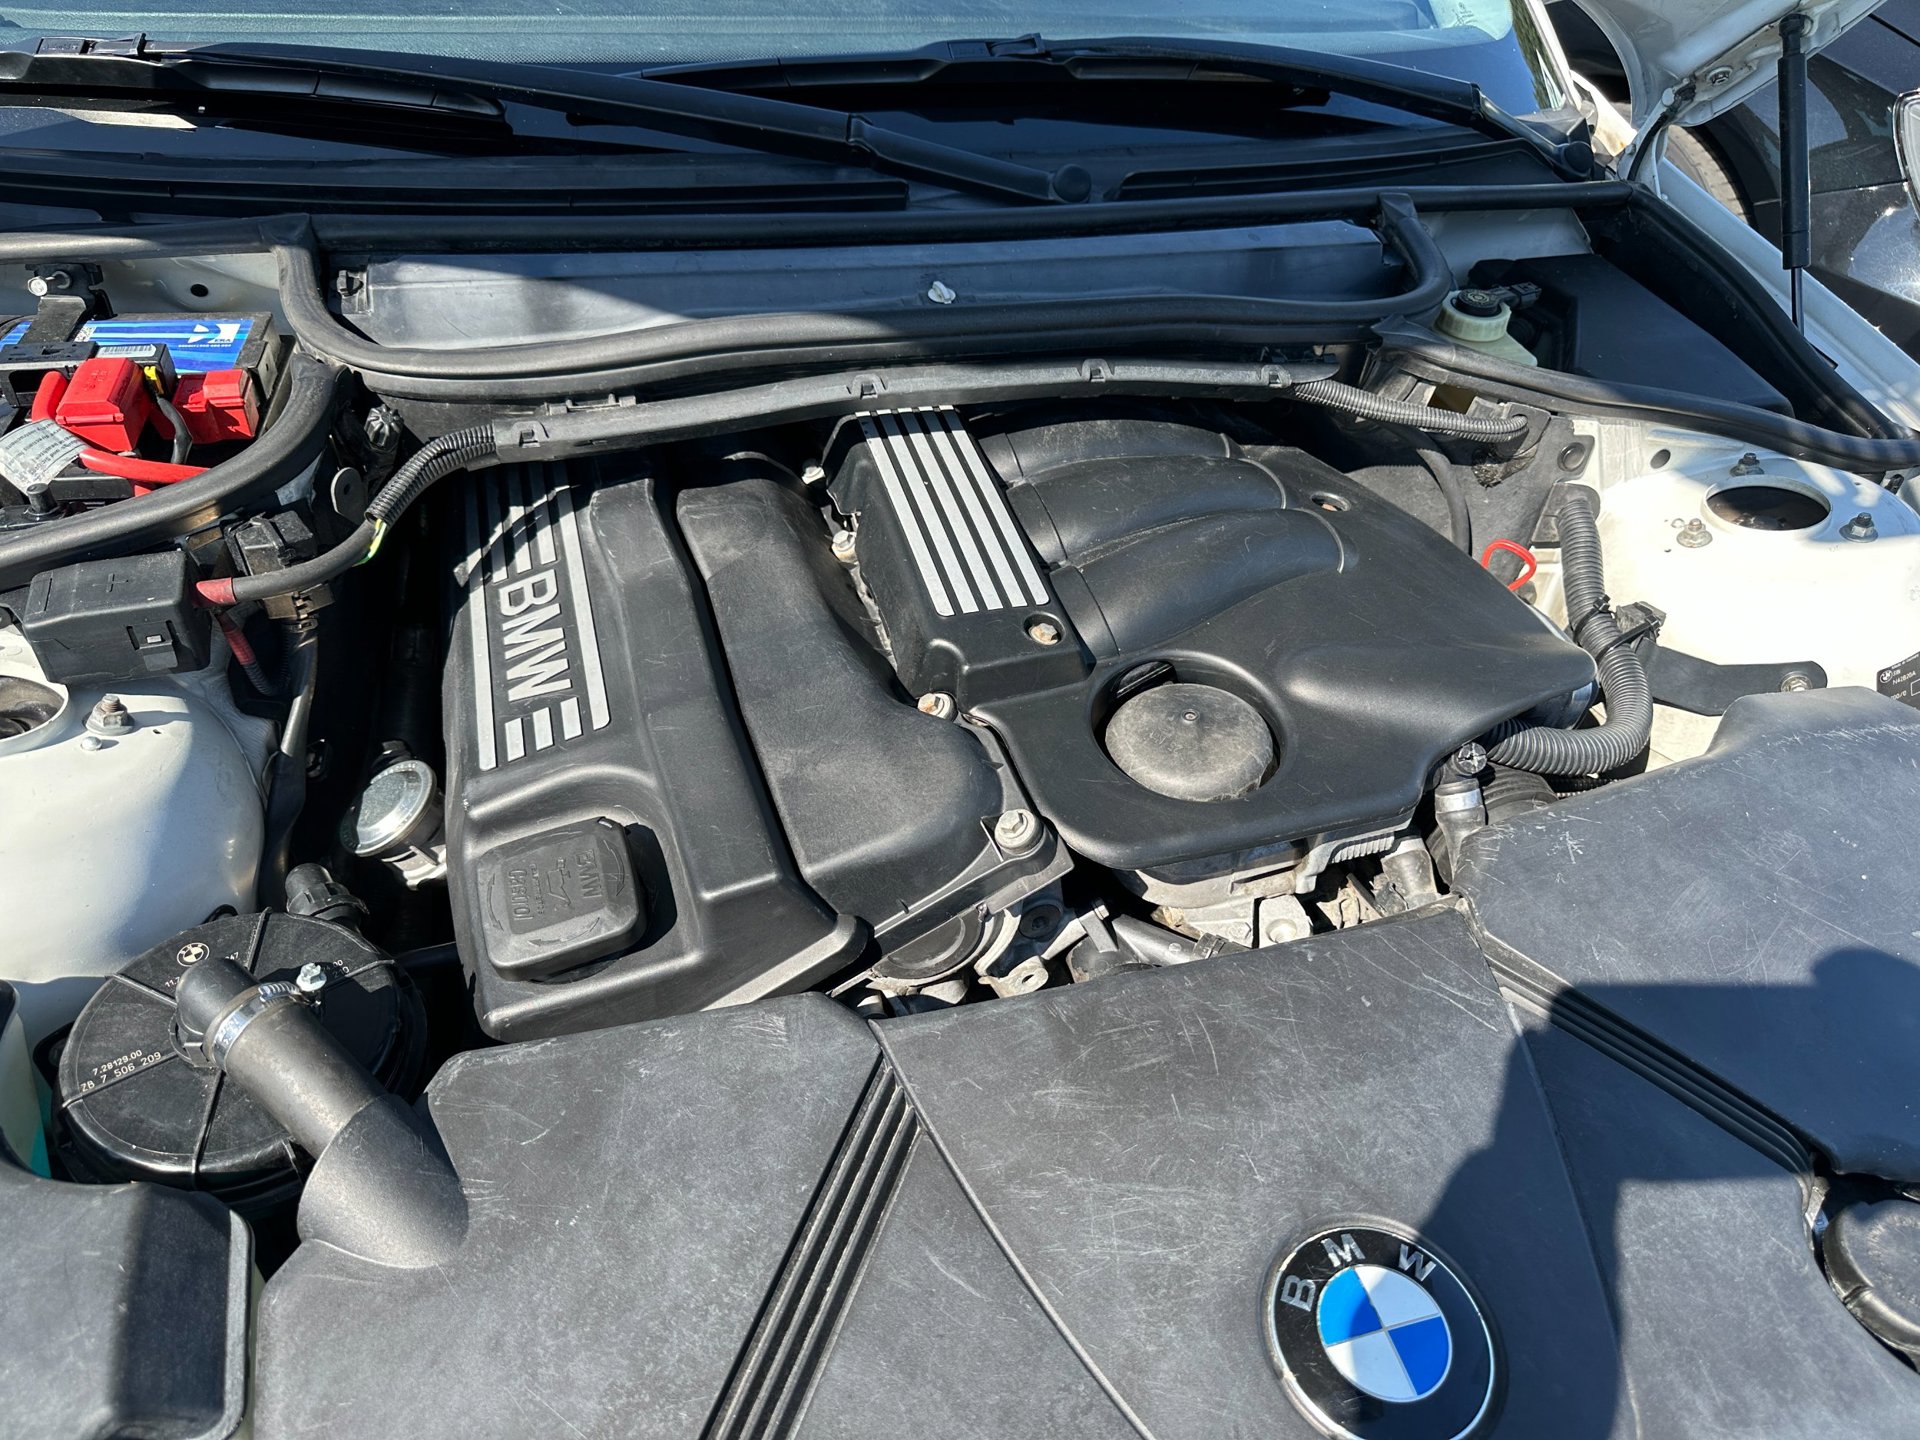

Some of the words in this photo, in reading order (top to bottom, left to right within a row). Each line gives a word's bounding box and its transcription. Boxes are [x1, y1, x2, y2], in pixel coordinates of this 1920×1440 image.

[498, 569, 572, 702] BMW
[507, 869, 534, 921] Castrol
[575, 849, 603, 899] BMW
[80, 1080, 95, 1092] ZB
[100, 1074, 107, 1084] 7
[113, 1062, 135, 1078] 506
[140, 1051, 162, 1066] 209
[92, 1049, 142, 1076] 7.28129.00
[1280, 1232, 1437, 1312] BMW
